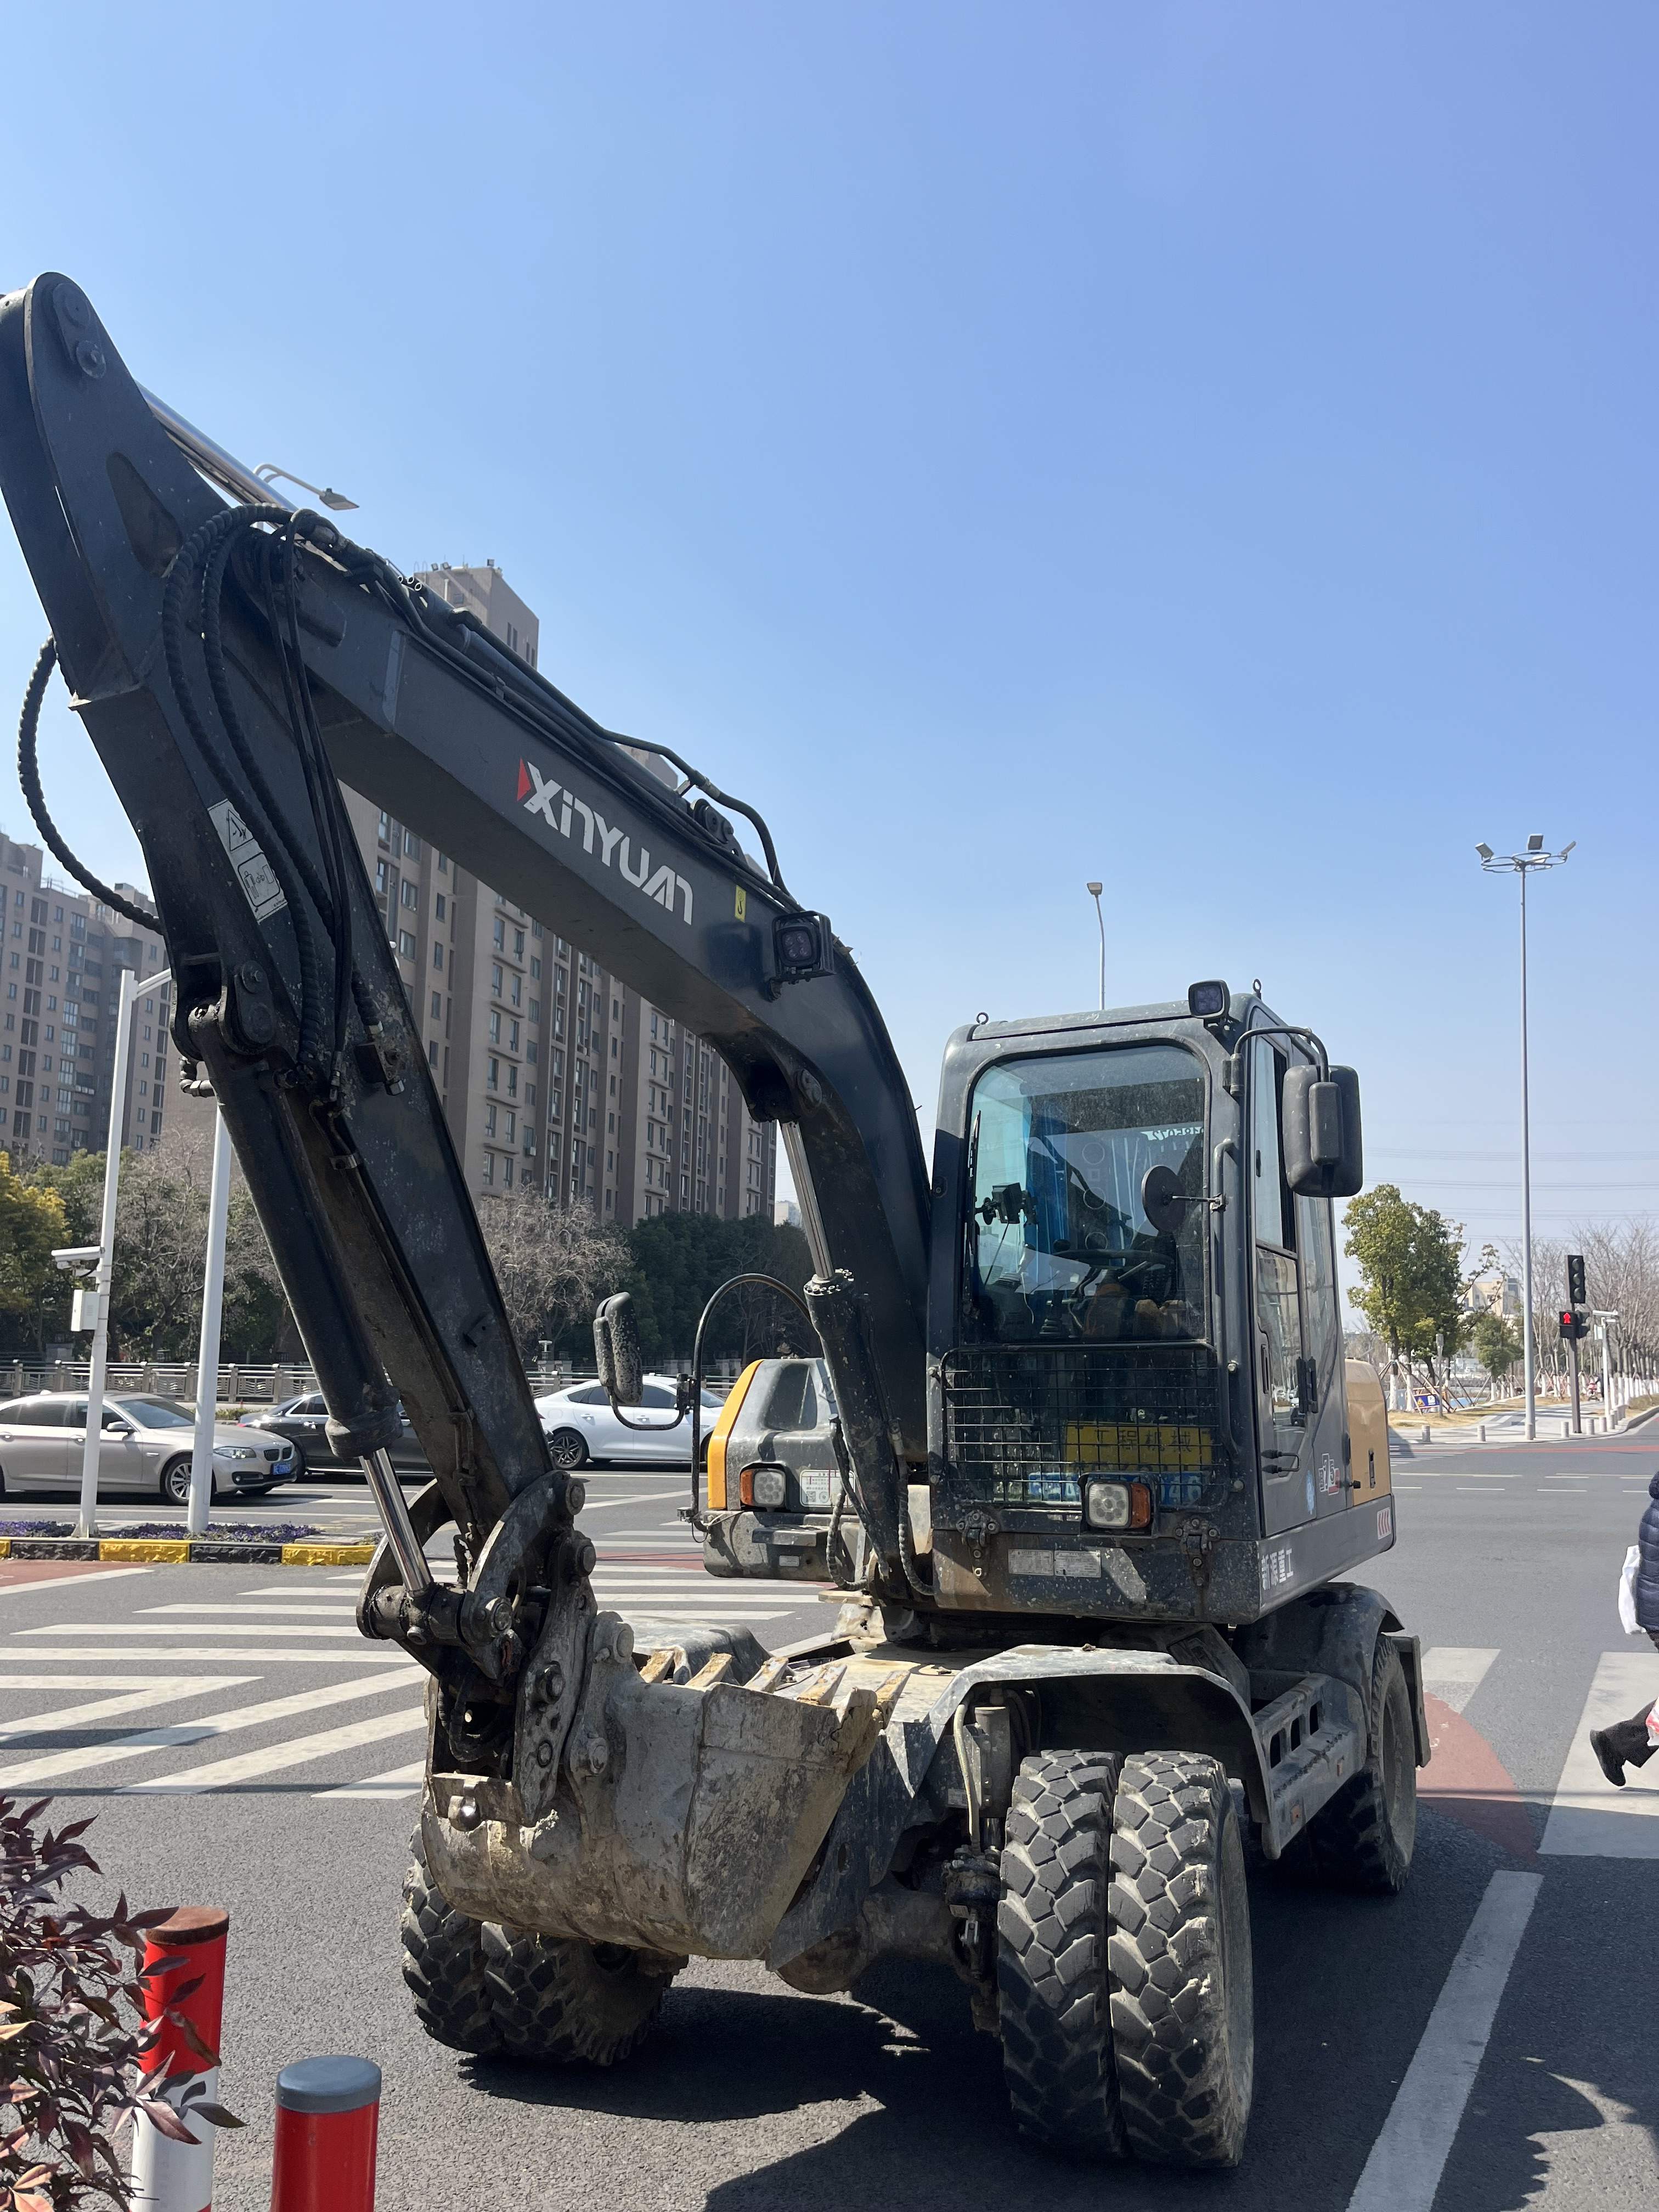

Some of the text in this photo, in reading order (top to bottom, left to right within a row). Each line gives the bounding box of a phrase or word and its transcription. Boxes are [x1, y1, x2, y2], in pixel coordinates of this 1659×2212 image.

[1093, 1430, 1192, 1453] 工程机械
[1261, 1548, 1294, 1590] 新源重工
